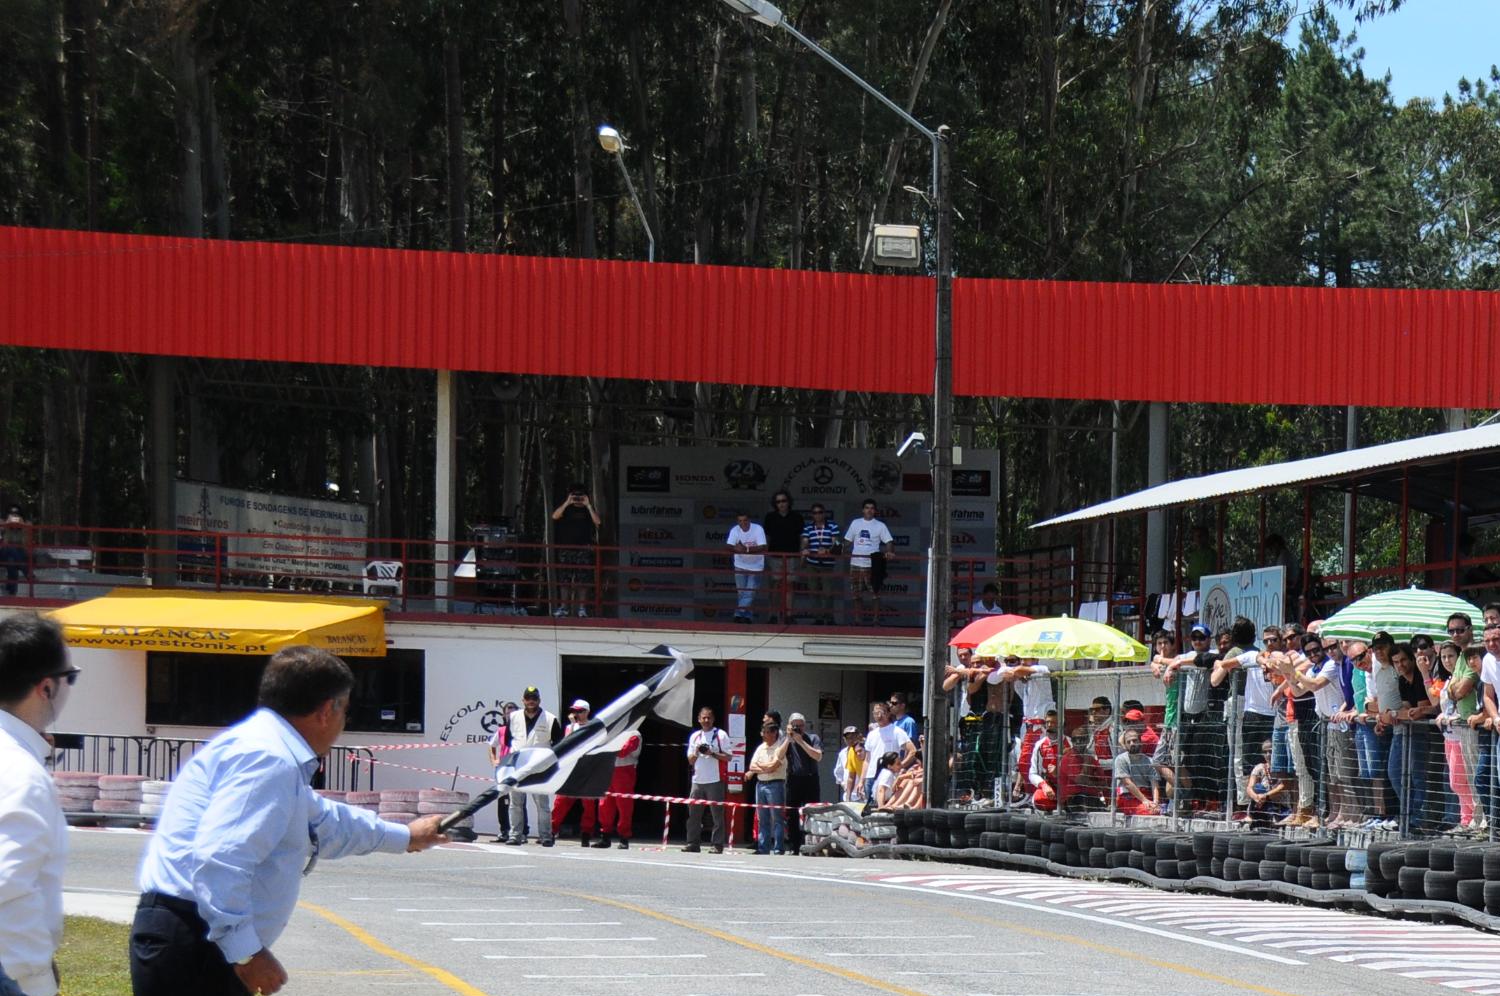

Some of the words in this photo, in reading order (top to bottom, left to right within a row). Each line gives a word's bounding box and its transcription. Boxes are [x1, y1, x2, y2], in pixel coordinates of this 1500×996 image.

[247, 501, 252, 509] E
[253, 502, 298, 515] SONDAGENS
[101, 627, 231, 642] BALANÇAS
[440, 700, 485, 742] ESCOLA
